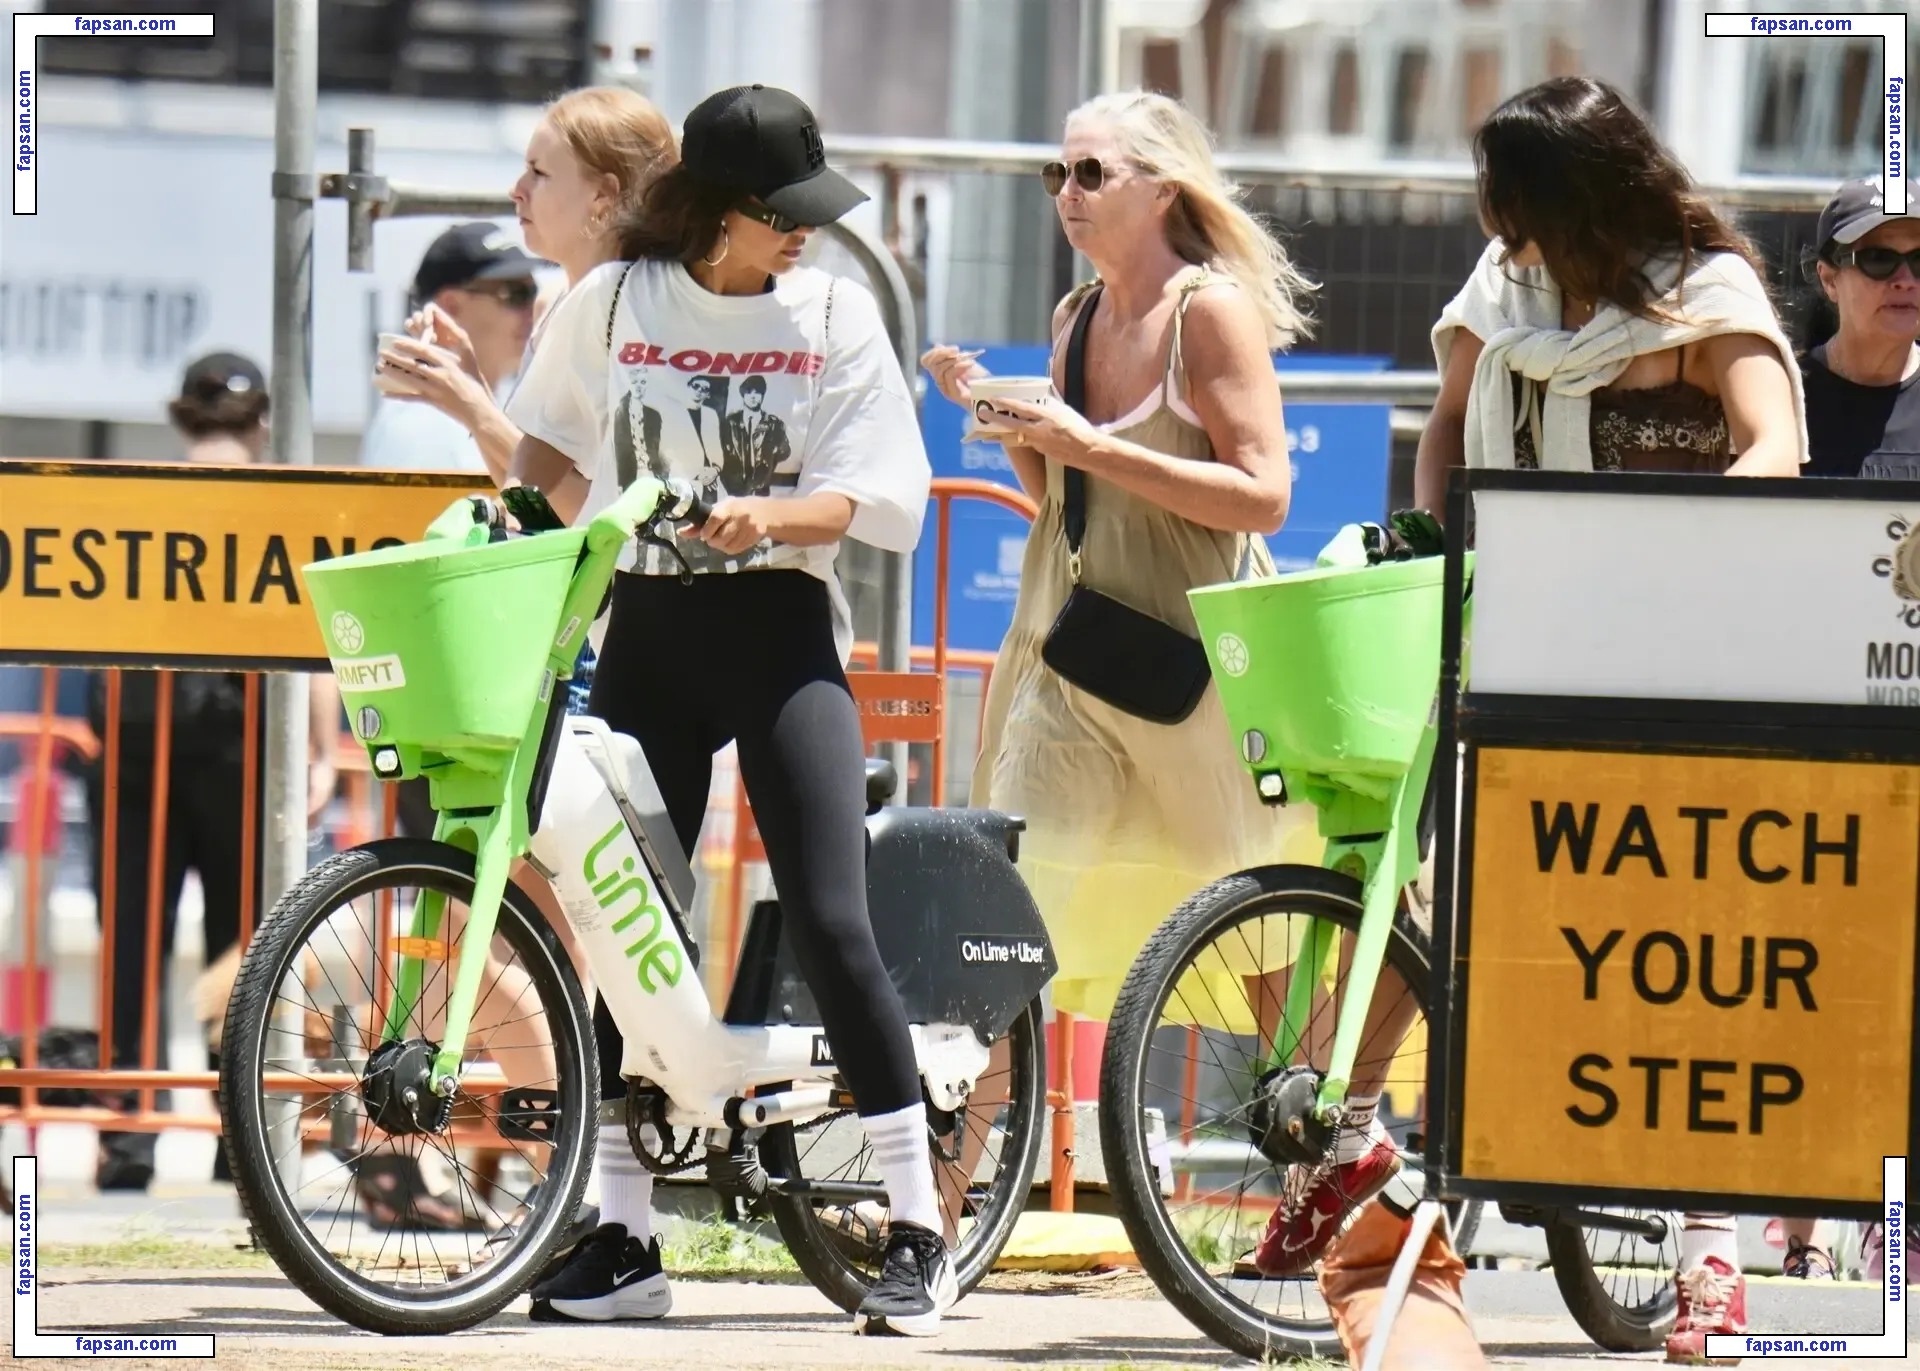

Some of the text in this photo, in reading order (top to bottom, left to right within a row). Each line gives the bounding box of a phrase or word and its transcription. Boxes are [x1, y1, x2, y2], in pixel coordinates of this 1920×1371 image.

[617, 342, 825, 377] BLONDIE
[0, 527, 408, 605] ESTRIA
[1866, 641, 1920, 681] MO
[1530, 800, 1860, 887] WATCH
[583, 819, 683, 996] Lime
[962, 940, 981, 962] On
[981, 941, 1009, 962] Lime
[1018, 942, 1044, 963] Uber
[1560, 927, 1819, 1012] YOUR
[817, 1039, 834, 1061] N
[1565, 1053, 1805, 1135] STEP
